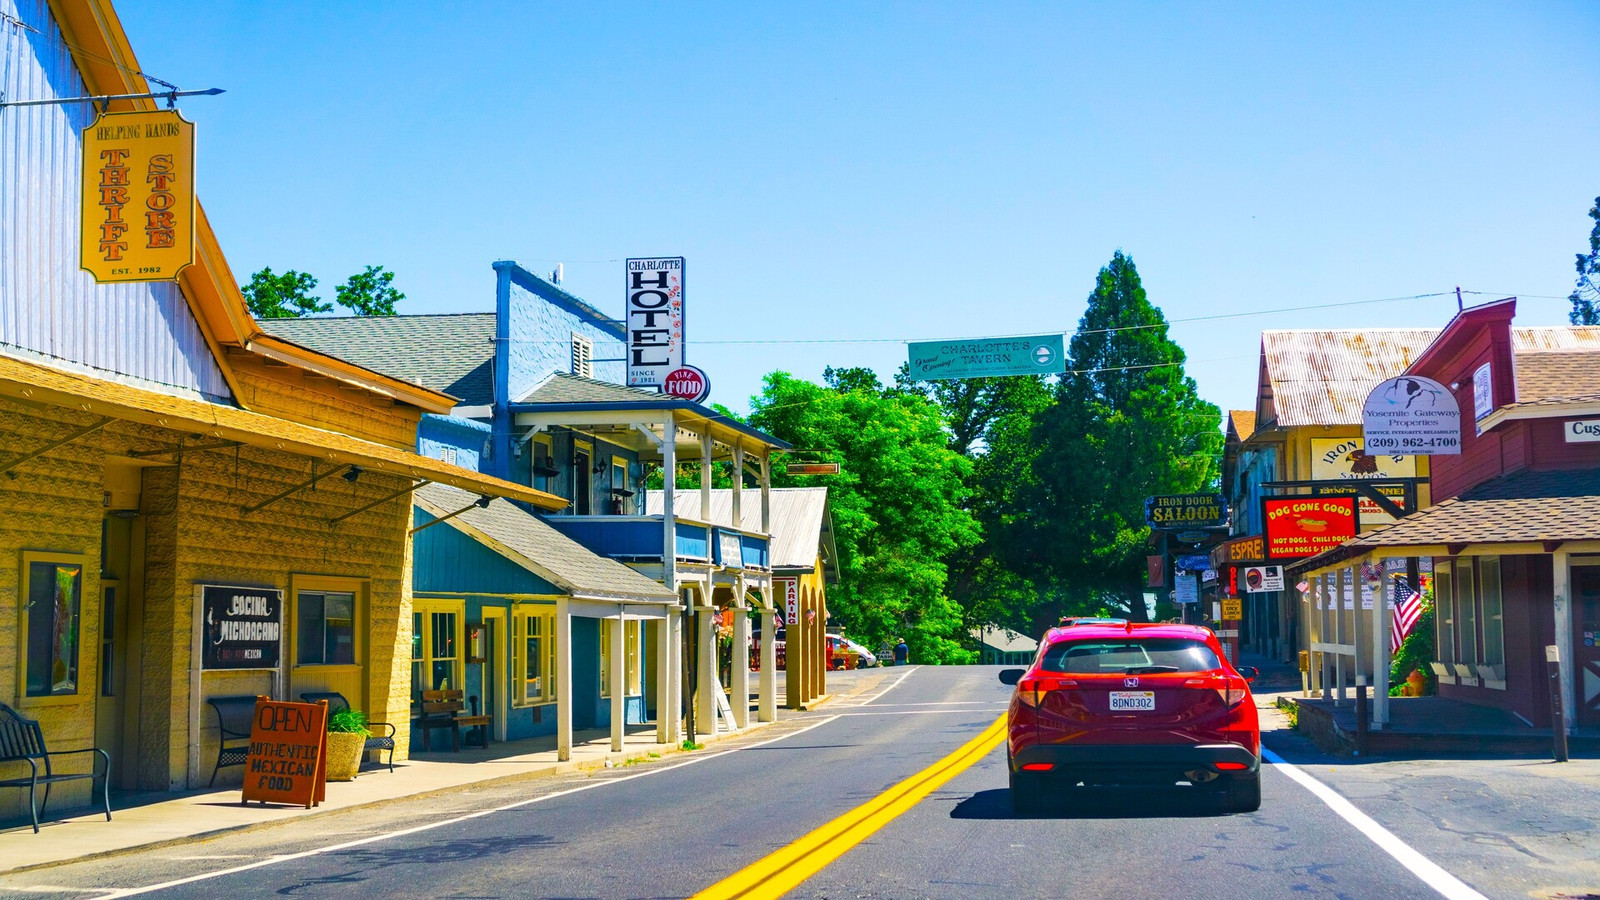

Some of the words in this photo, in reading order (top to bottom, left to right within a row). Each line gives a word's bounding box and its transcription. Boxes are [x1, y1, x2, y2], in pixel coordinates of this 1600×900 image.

[97, 124, 140, 140] HELPING
[145, 122, 180, 138] HANDS
[99, 149, 130, 261] THRIFT
[145, 154, 177, 249] STORE
[138, 266, 161, 274] 1982
[629, 260, 680, 270] CHARLOTTE
[631, 271, 669, 366] HOTEL
[941, 341, 1031, 355] CHARLOTTE'S
[915, 355, 939, 367] Grand
[961, 353, 1011, 365] TAVERN
[675, 371, 693, 379] FINE
[667, 380, 701, 395] FOOD
[1389, 419, 1439, 427] Properties
[1573, 421, 1600, 436] Cus
[1368, 438, 1399, 448] (209)
[1402, 437, 1457, 447] 962-4700
[1323, 440, 1357, 464] IRON
[1159, 498, 1182, 506] IRON
[1186, 496, 1213, 505] DOOR
[1153, 506, 1220, 522] SALOON
[1268, 506, 1290, 520] DOG
[1293, 503, 1320, 512] GONE
[1323, 503, 1351, 516] GOOD
[1230, 538, 1265, 560] ESPRE
[226, 595, 272, 616] COCINA
[788, 581, 796, 625] PARKING
[213, 620, 279, 645] MICHOACANA
[244, 649, 262, 659] MEXICAN
[259, 705, 312, 733] OPEN
[250, 741, 318, 760] AUTHENTIC
[251, 758, 314, 777] MEXICAN
[258, 775, 293, 792] FOOD
